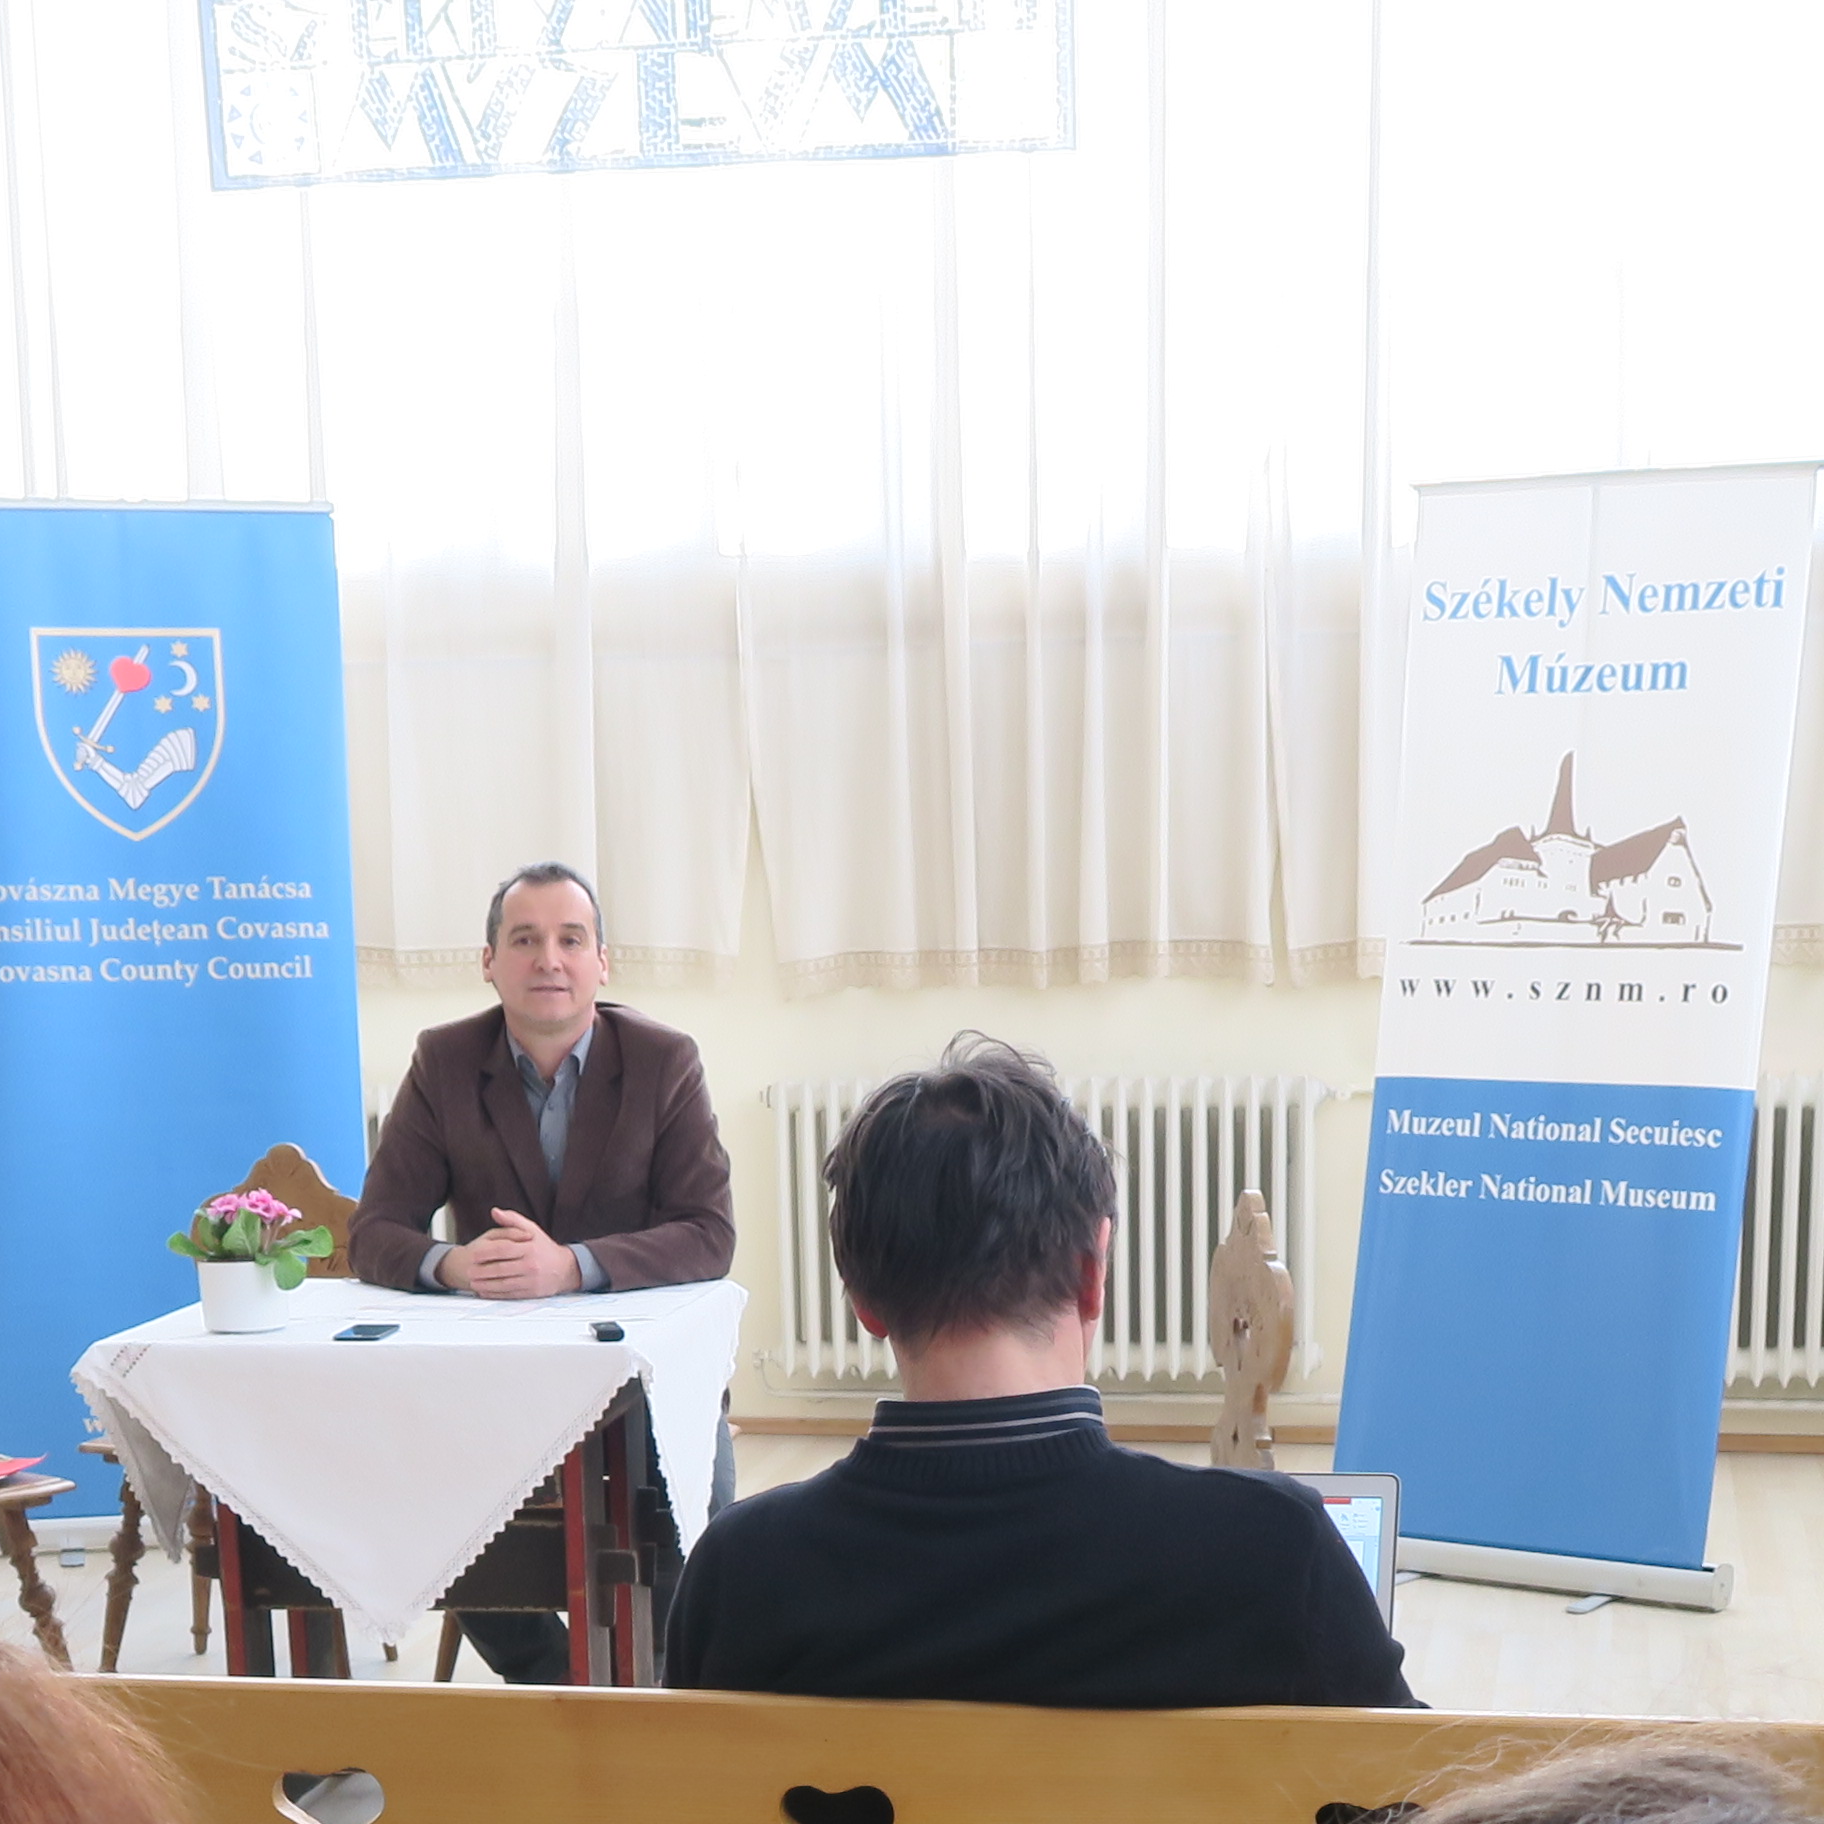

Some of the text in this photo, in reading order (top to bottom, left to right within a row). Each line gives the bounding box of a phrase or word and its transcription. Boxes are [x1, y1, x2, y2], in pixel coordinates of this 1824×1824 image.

[1422, 566, 1786, 628] Székely Nemzeti
[1495, 649, 1688, 695] Múzeum
[108, 878, 200, 908] Megye
[207, 875, 312, 900] Tanácsa
[217, 916, 329, 939] Covasna
[100, 958, 200, 988] County
[207, 955, 312, 980] Council
[1386, 1109, 1722, 1149] Muzeul National Secuiesc
[1379, 1168, 1716, 1211] Szekler National Museum
